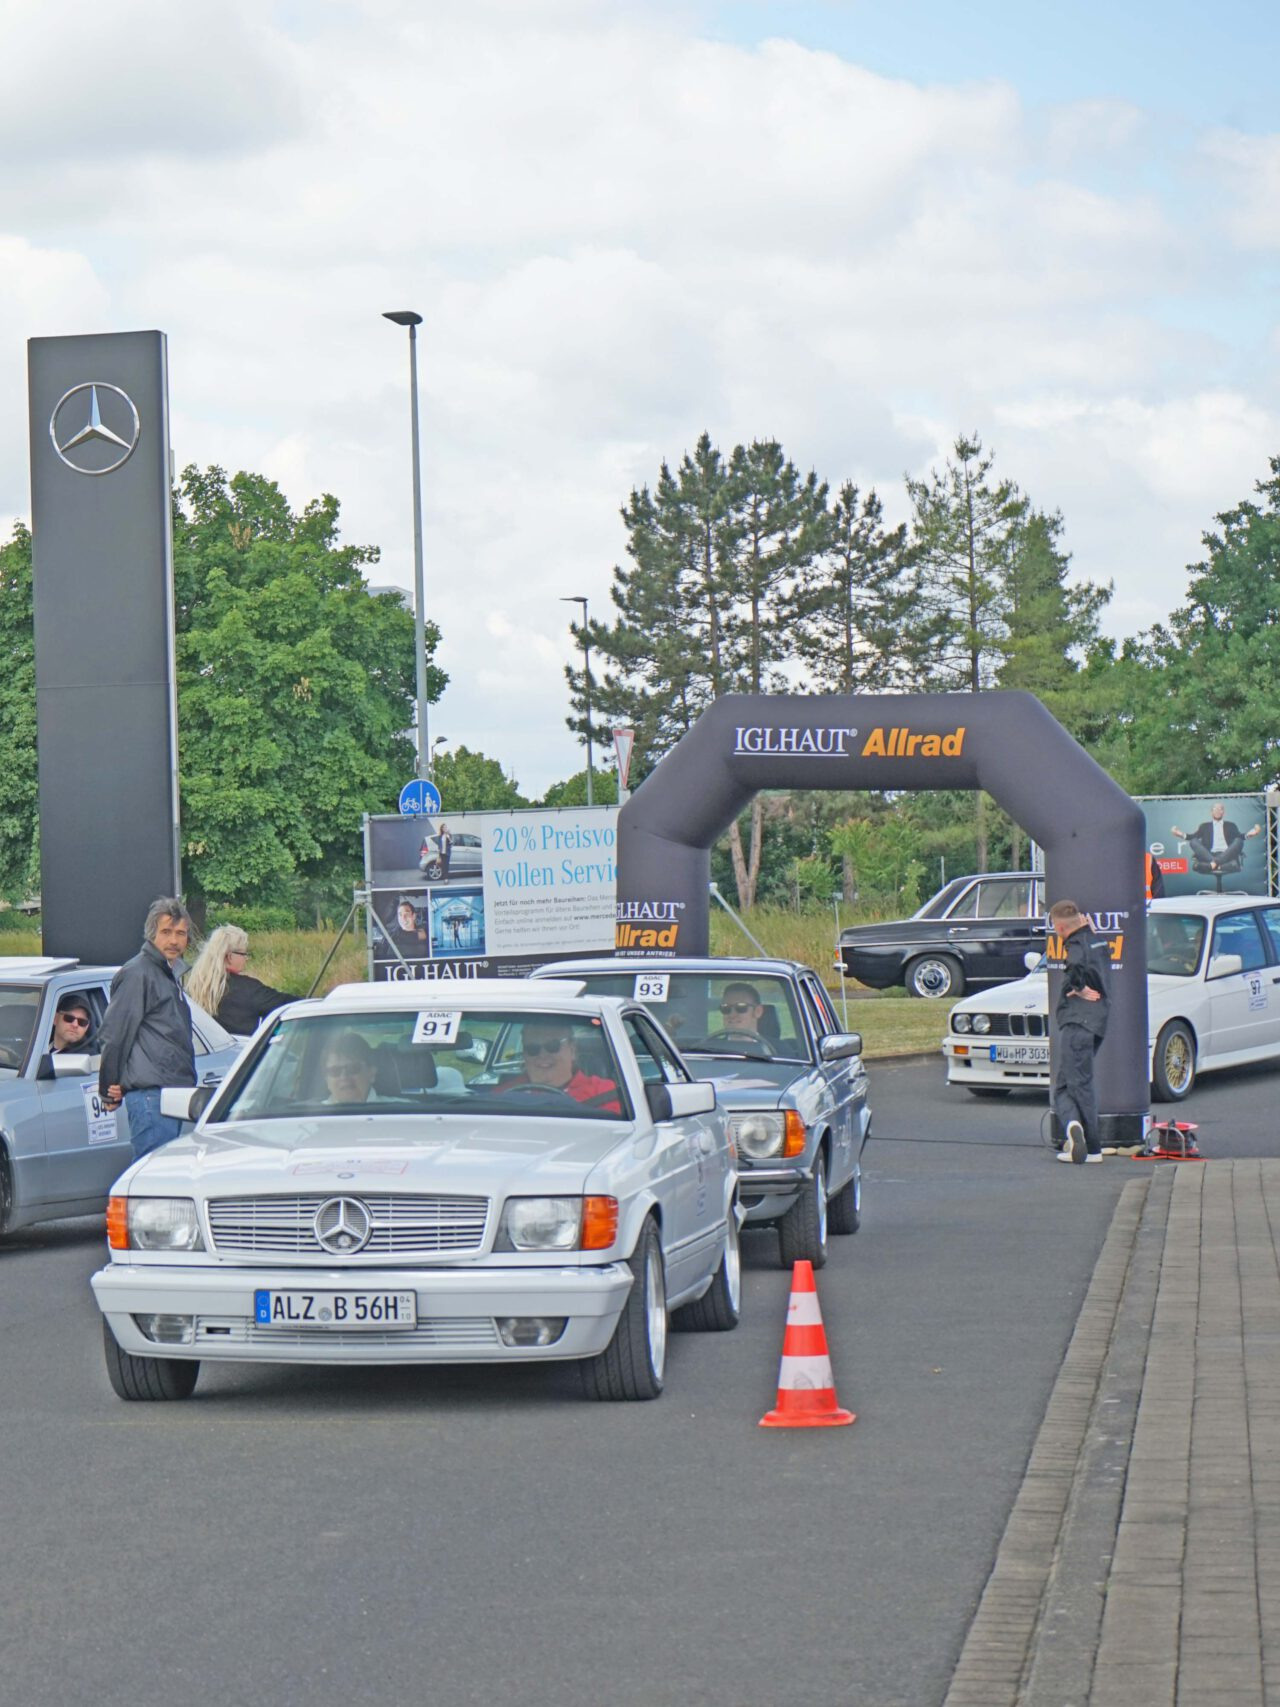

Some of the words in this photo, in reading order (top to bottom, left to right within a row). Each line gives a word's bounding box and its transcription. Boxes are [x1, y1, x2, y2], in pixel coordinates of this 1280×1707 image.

[861, 727, 966, 757] Allrad
[541, 823, 615, 850] Preisvo
[493, 861, 555, 888] vollen
[561, 857, 618, 885] Servi
[639, 983, 663, 996] 93
[1250, 979, 1261, 995] 97
[422, 1021, 452, 1036] 91
[399, 1295, 411, 1303] 04
[273, 1295, 315, 1321] ALZ
[333, 1295, 348, 1320] B
[355, 1295, 398, 1320] 56H
[400, 1312, 412, 1320] 10
